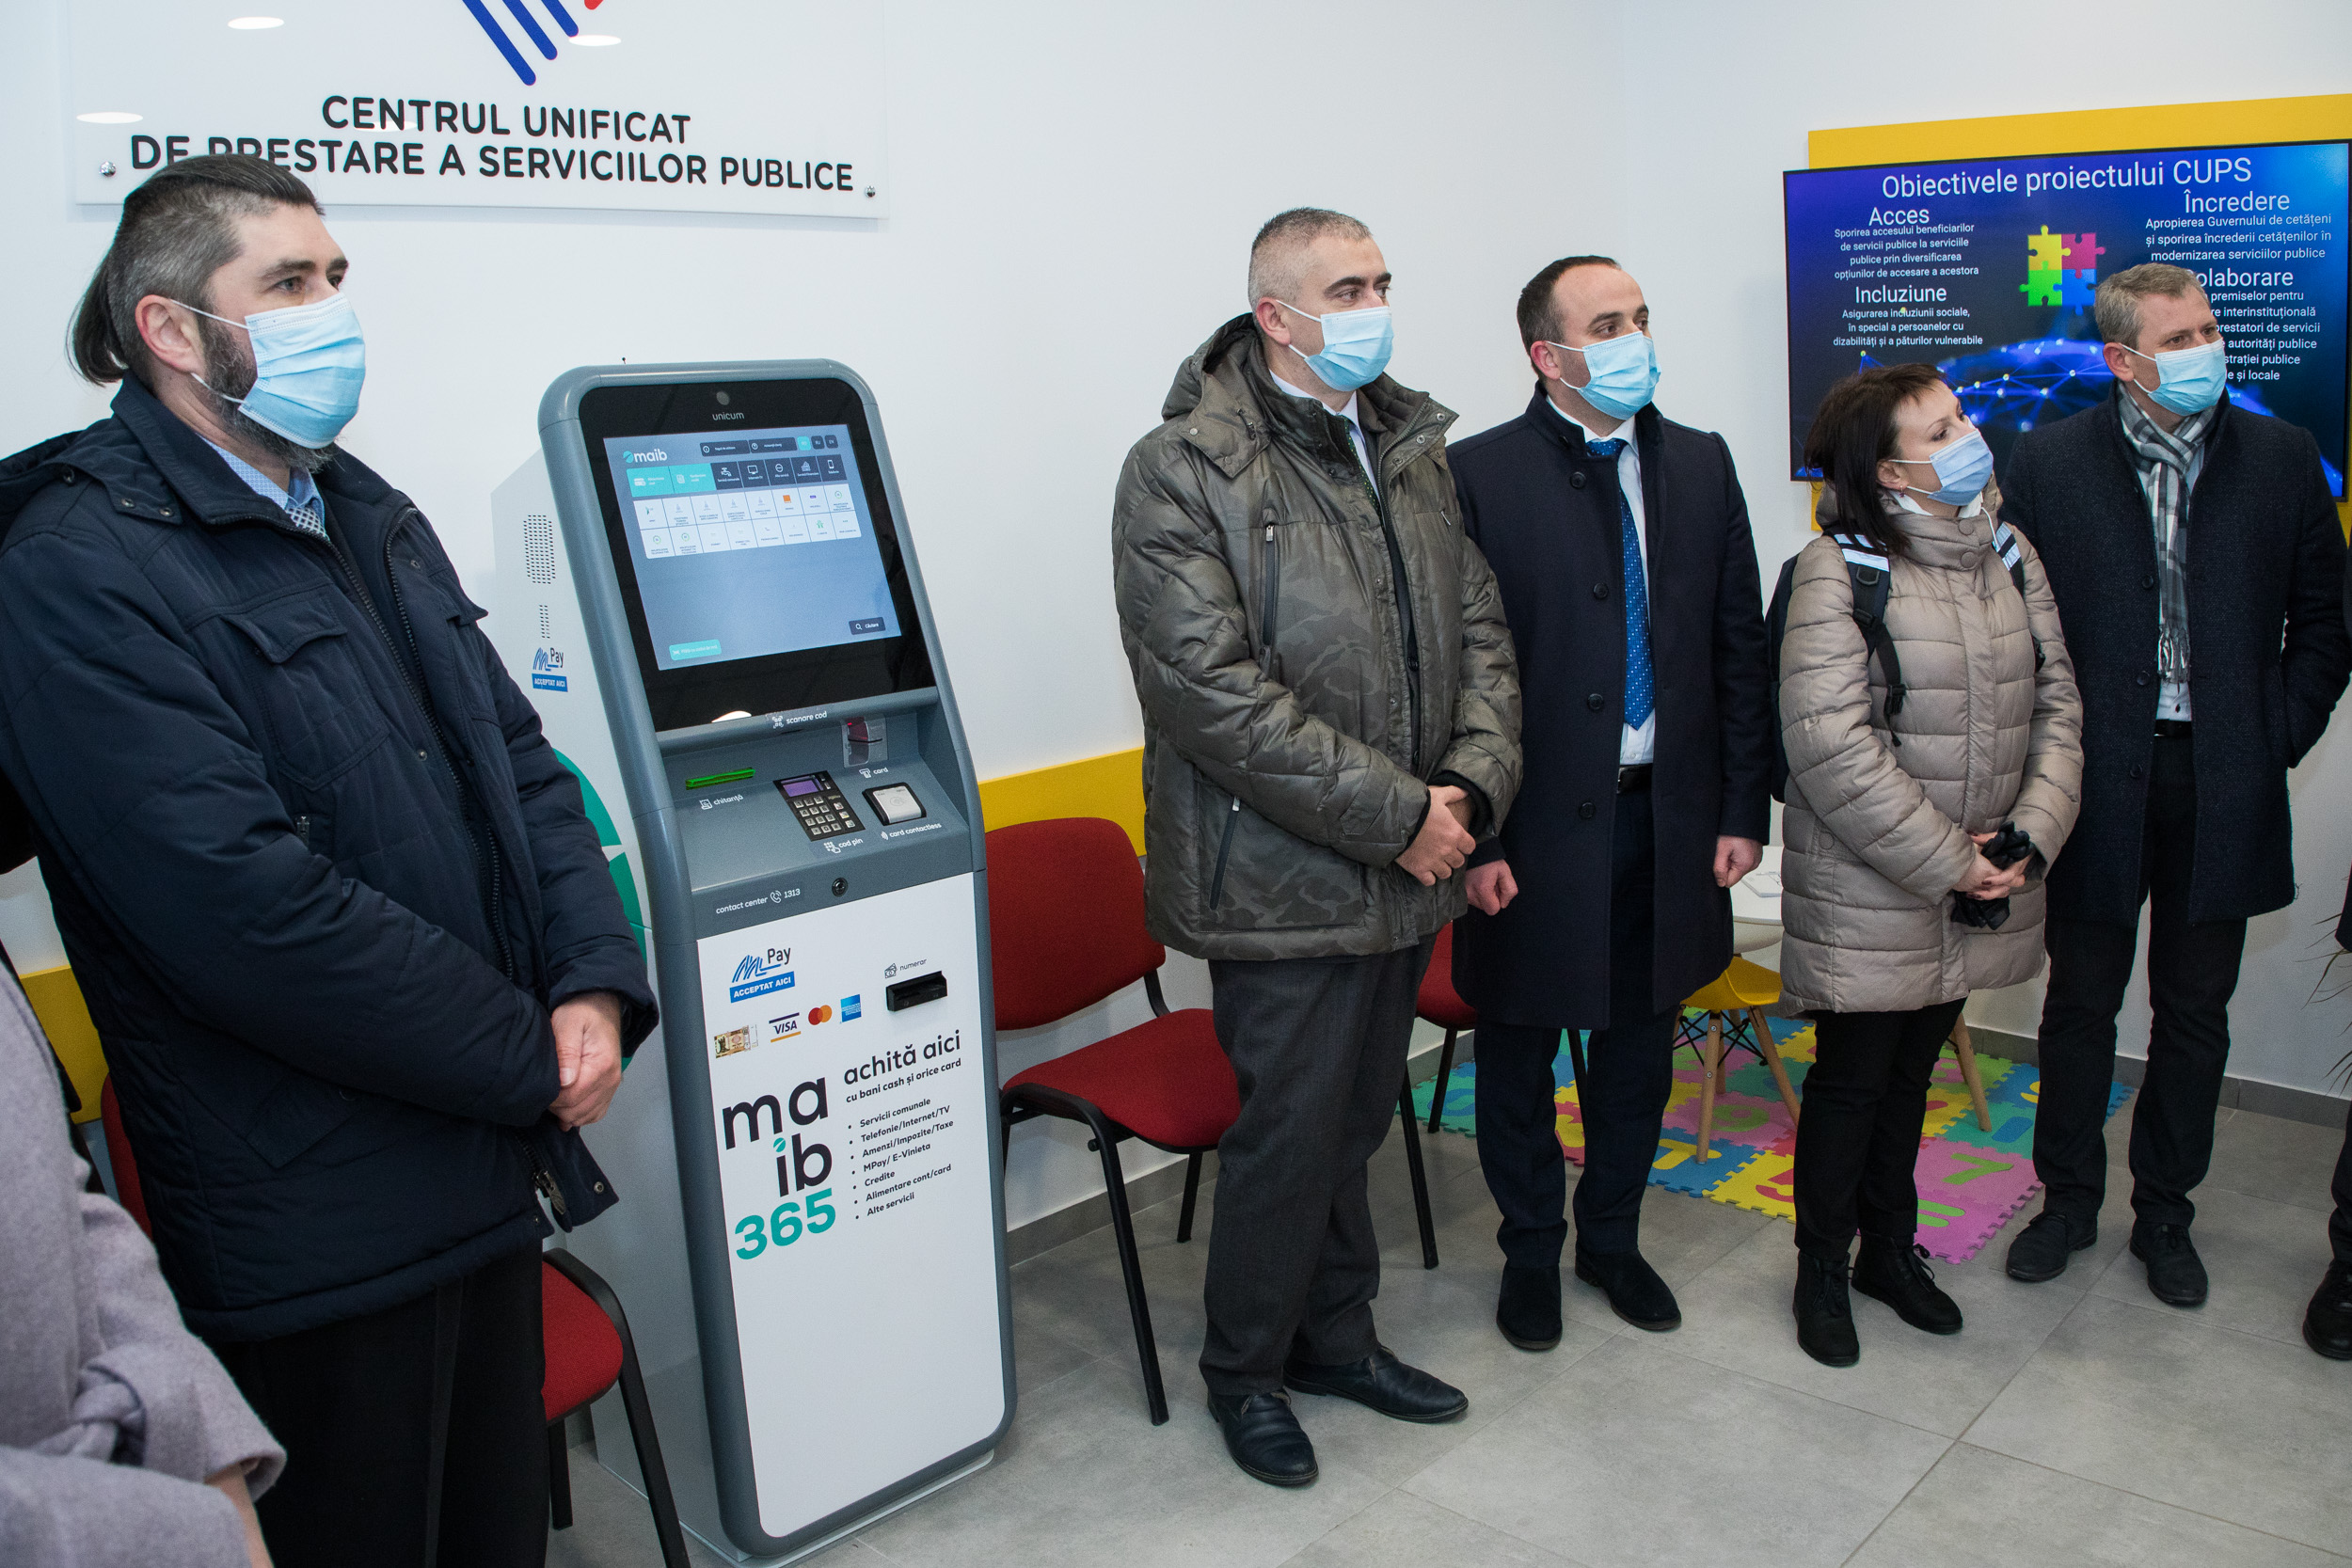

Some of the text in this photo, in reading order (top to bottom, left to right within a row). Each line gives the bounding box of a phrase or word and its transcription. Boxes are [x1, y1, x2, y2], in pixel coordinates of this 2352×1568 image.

[322, 95, 691, 144] CENTRUL UNIFICAT
[131, 135, 190, 169] DE
[439, 144, 466, 176] A
[479, 145, 707, 184] SERVICIILOR
[721, 157, 853, 191] PUBLICE
[1882, 157, 2252, 199] Obiectivele proiectului CUPS
[2184, 189, 2290, 214] Încredere
[1868, 207, 1930, 226] Acces
[2145, 218, 2204, 230] Apropierea
[2207, 215, 2266, 227] Guvernului
[2269, 214, 2283, 225] de
[1835, 223, 1975, 239] Sporirea accesului beneficiarilor
[2157, 234, 2201, 246] sporirea
[2204, 232, 2255, 244] încrederii
[2321, 230, 2332, 241] în
[1840, 237, 1969, 251] de servicii publice la serviciile
[1850, 252, 1962, 266] publice prin diversificarea
[2151, 247, 2326, 261] modernizarea serviciilor publice
[1877, 268, 1888, 277] de
[1939, 266, 1979, 276] acestora
[2186, 268, 2294, 288] olaborare
[1855, 285, 1947, 304] Incluziune
[2211, 291, 2267, 304] premiselor
[2269, 292, 2304, 304] pentru
[1842, 307, 1970, 320] Asigurarea incluziunii sociale,
[1848, 323, 1856, 332] în
[1858, 322, 1889, 334] special
[1899, 322, 1951, 333] persoanelor
[2266, 323, 2280, 333] de
[2282, 323, 2321, 333] servicii
[1896, 336, 1932, 347] păturilor
[1934, 335, 1983, 345] vulnerabile
[2278, 339, 2318, 351] publice
[2262, 354, 2301, 367] publice
[2248, 370, 2280, 381] locale
[712, 412, 745, 421] unicum
[633, 448, 668, 463] maib
[534, 678, 556, 687] ACCEPTAT
[786, 711, 828, 725] scanare cod
[889, 822, 942, 839] card contactless
[838, 837, 864, 848] cod pin
[716, 888, 801, 914] contact center 1313
[899, 958, 928, 971] numerar
[734, 976, 791, 998] ACCEPTAT AICI
[773, 1020, 798, 1035] VISA
[844, 1029, 961, 1085] achită aici
[846, 1093, 858, 1103] cu
[859, 1084, 882, 1100] bani
[882, 1077, 904, 1091] cash
[915, 1068, 939, 1081] orice
[940, 1057, 961, 1072] card
[722, 1077, 829, 1149] ma
[860, 1098, 931, 1128] Servicii comunale
[861, 1105, 950, 1143] Telefonie/Internet/TV
[862, 1120, 954, 1158] Amenzi/Impozite/Taxe
[863, 1143, 931, 1172] MPay/ E-Vinieta
[865, 1171, 896, 1187] Credite
[866, 1164, 952, 1202] Alimentare cont/card
[866, 1192, 915, 1216] Alte servicii
[734, 1187, 836, 1260] 365
